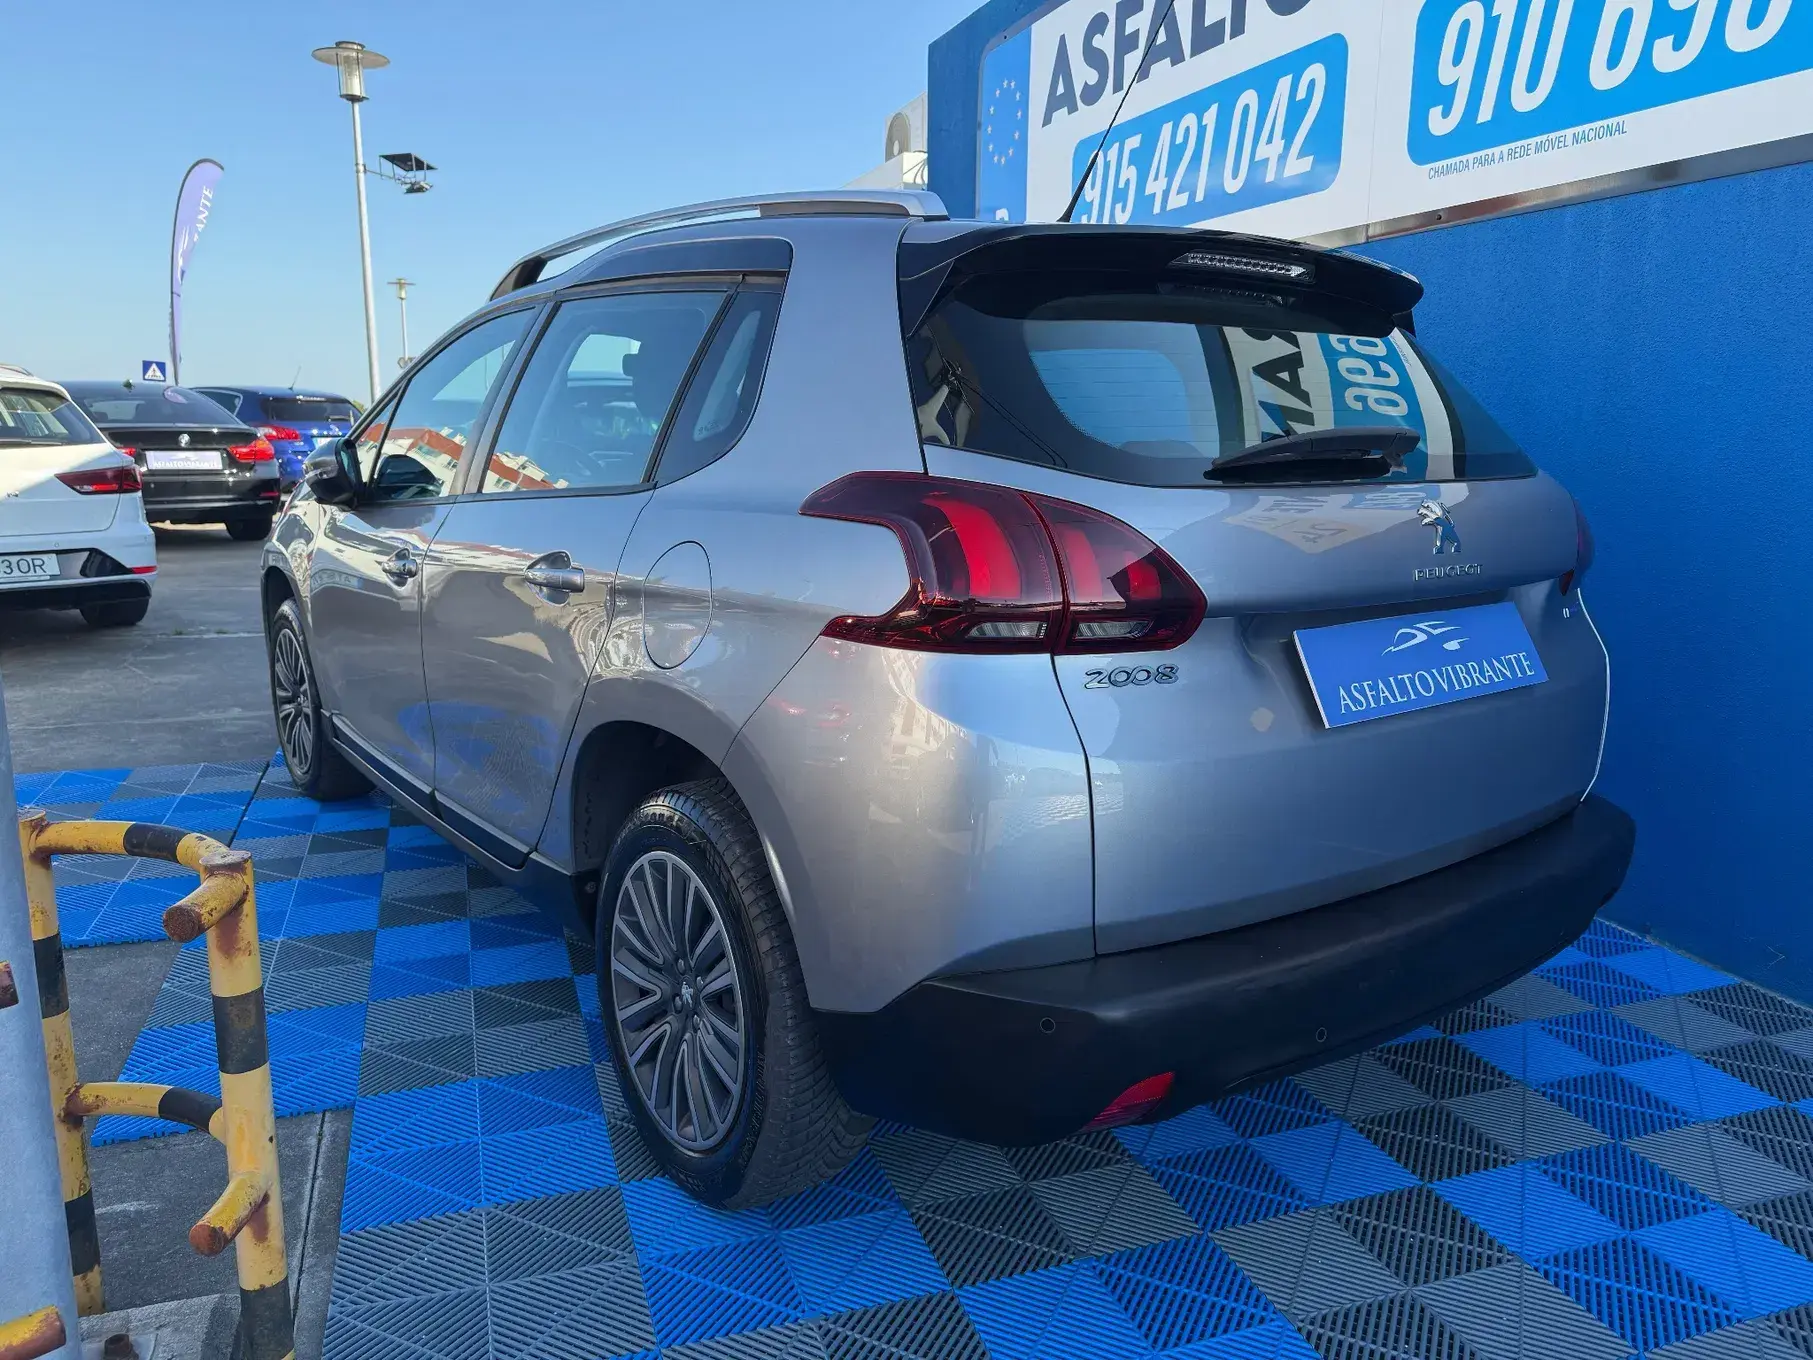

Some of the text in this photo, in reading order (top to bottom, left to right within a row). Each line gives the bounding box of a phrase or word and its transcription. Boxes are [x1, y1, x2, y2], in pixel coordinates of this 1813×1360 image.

[1427, 0, 1571, 136] 910
[1082, 62, 1327, 224] 915 421 042
[1428, 120, 1628, 180] CHAMADA PARA A REDE MÓVEL NACIONAL
[1413, 563, 1483, 581] PEUGEOT
[1084, 663, 1180, 690] 2008
[1340, 650, 1535, 714] ASFALTOVIBRANTE
